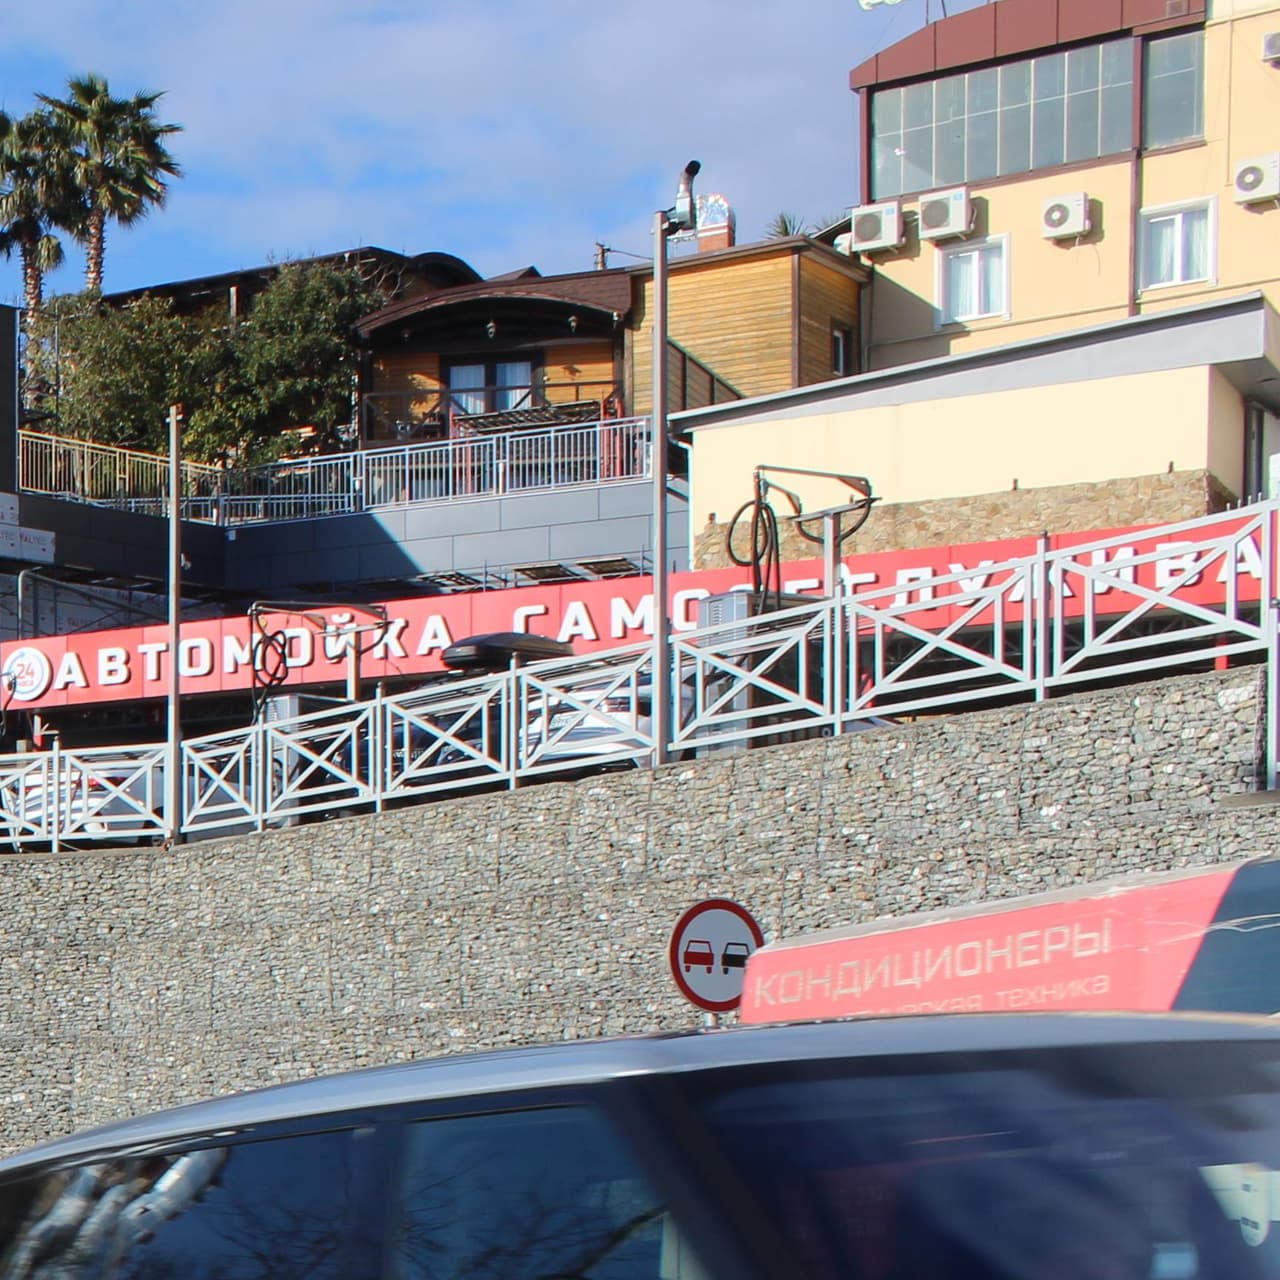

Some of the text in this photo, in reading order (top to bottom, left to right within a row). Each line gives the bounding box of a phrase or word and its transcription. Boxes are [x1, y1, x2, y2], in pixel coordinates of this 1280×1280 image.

[16, 662, 34, 679] 24
[53, 613, 454, 690] АВТОМОЙКА
[754, 918, 1113, 1007] КОНДИЦИОНЕРЫ
[996, 974, 1111, 1009] техника
